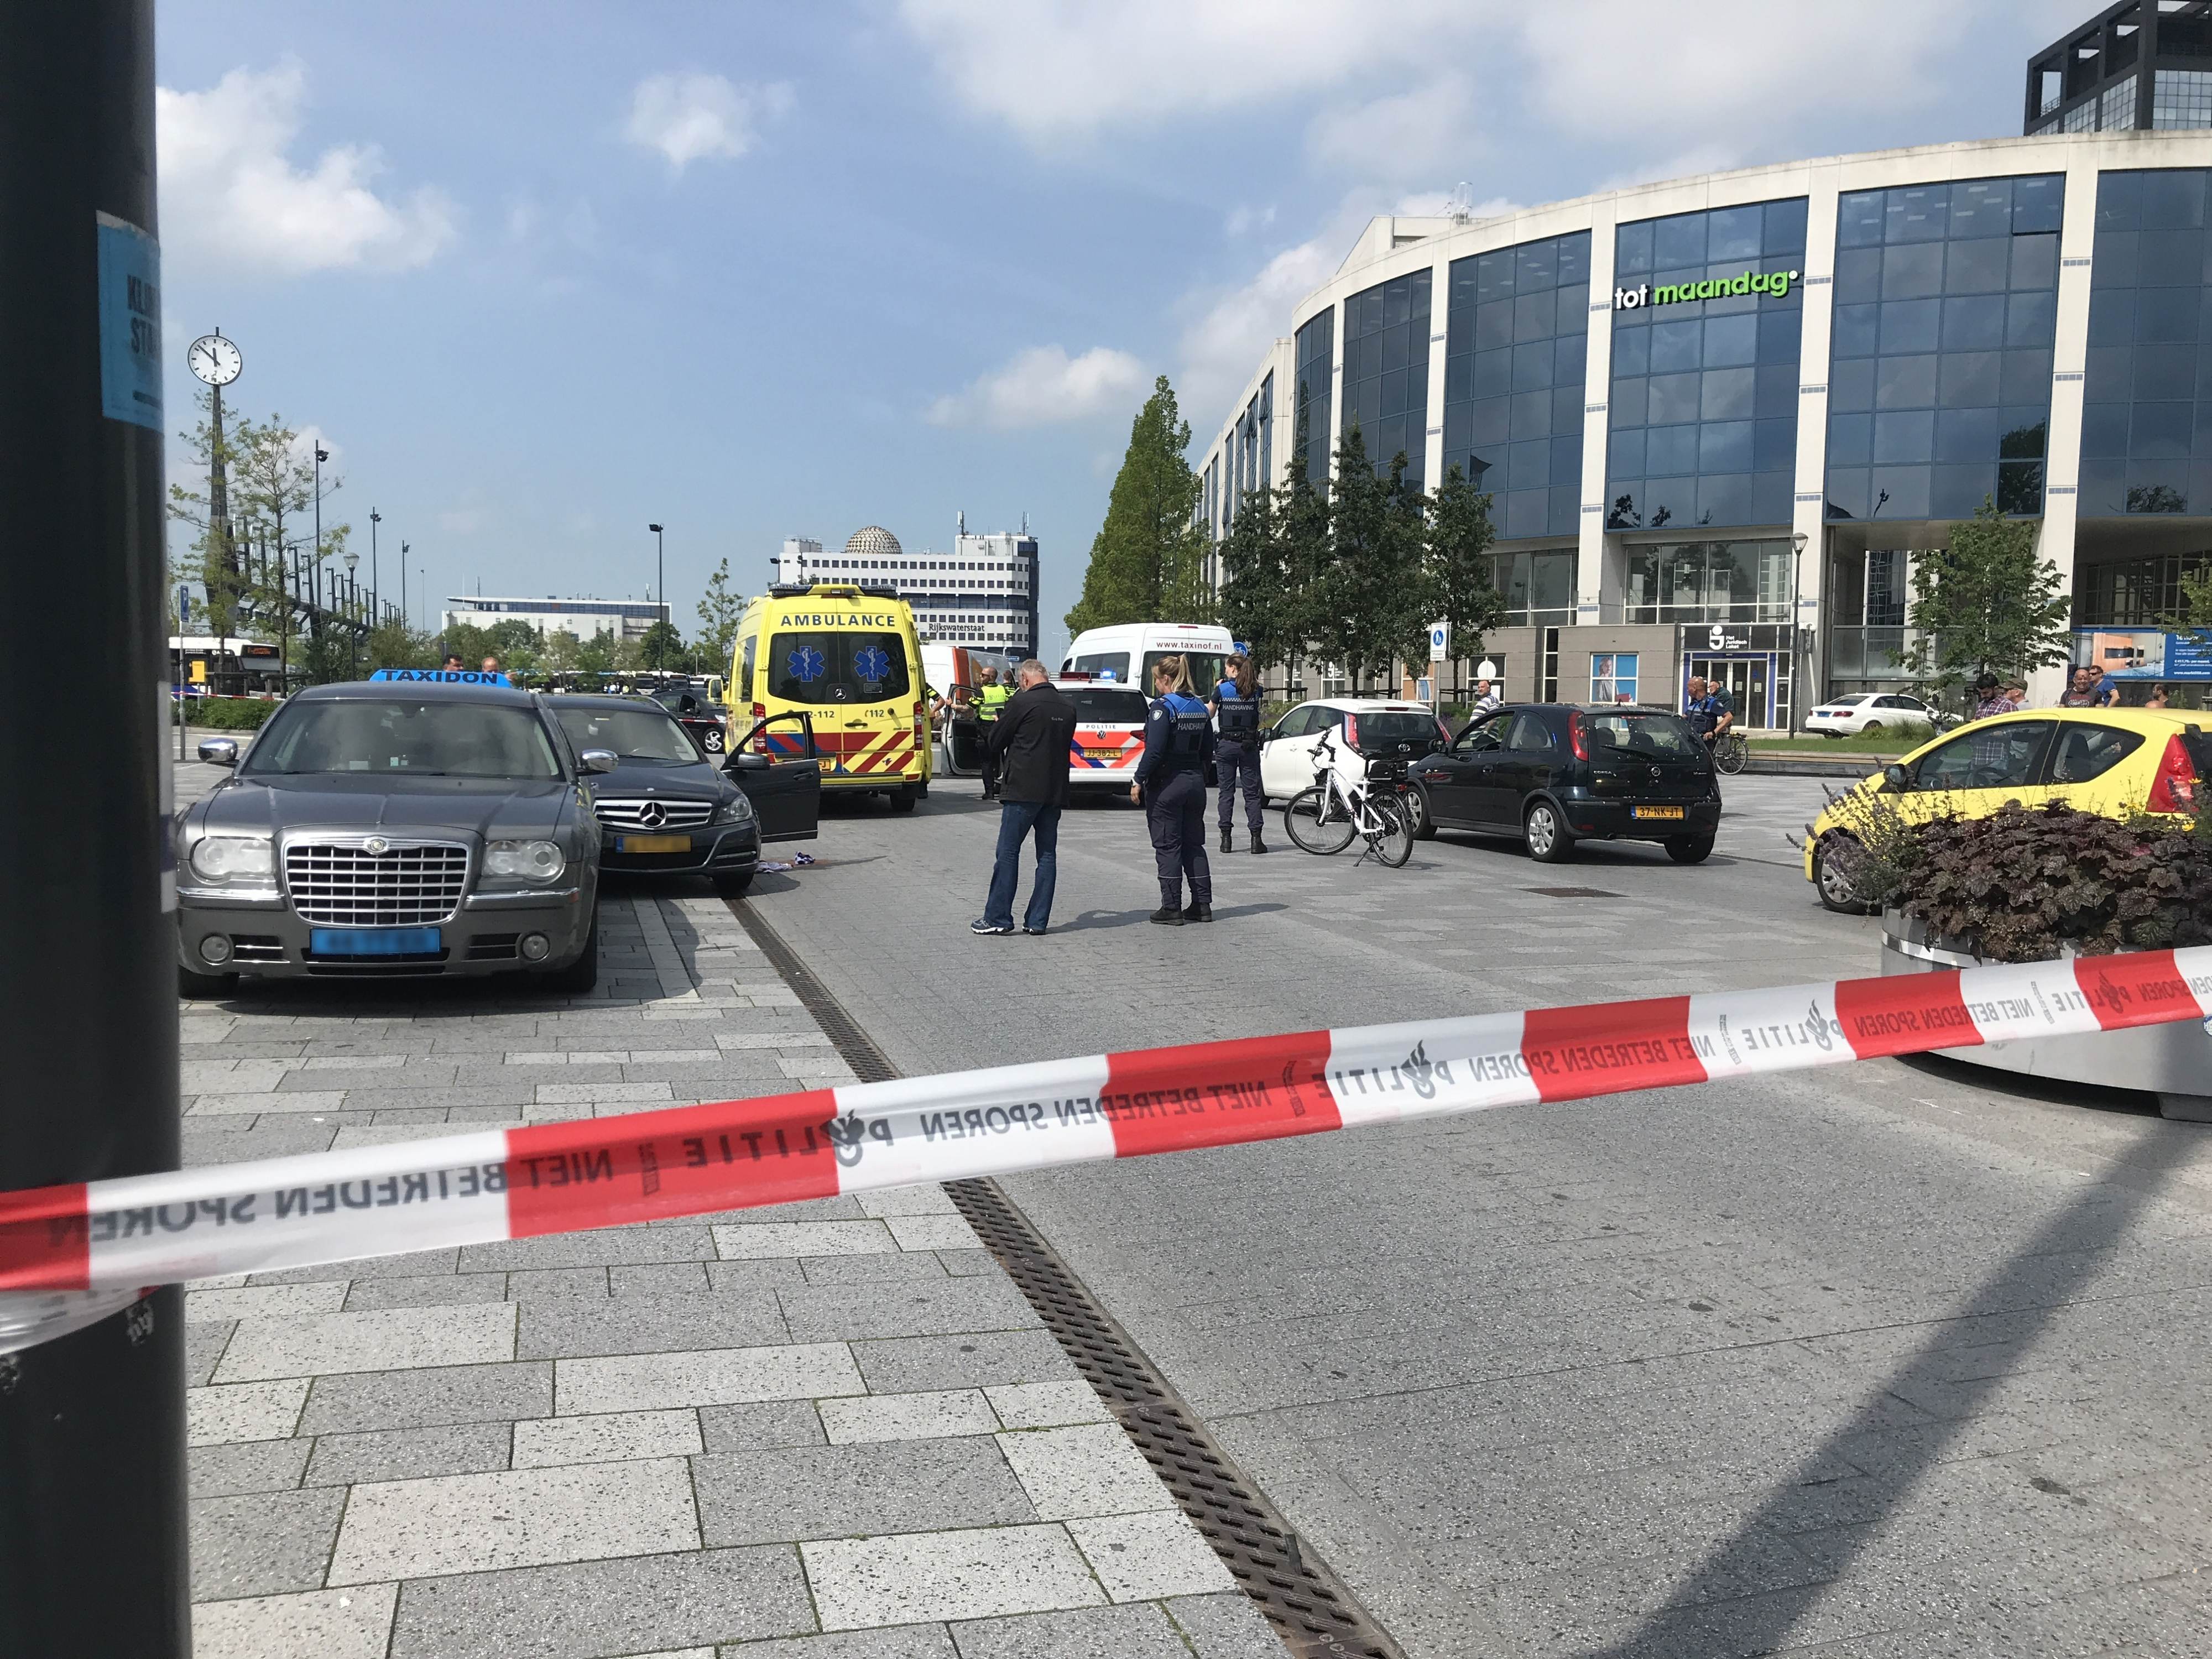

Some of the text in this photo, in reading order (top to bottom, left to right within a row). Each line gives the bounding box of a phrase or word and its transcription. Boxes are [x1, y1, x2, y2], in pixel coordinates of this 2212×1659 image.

[1615, 271, 1788, 309] tot maandag
[781, 614, 895, 627] AMBULANCE
[929, 623, 984, 633] Rijkswaterstaat
[1156, 641, 1222, 650] www.taxinof.nl
[382, 670, 497, 684] TAXIDON
[1640, 807, 1679, 816] 37-NK-JT
